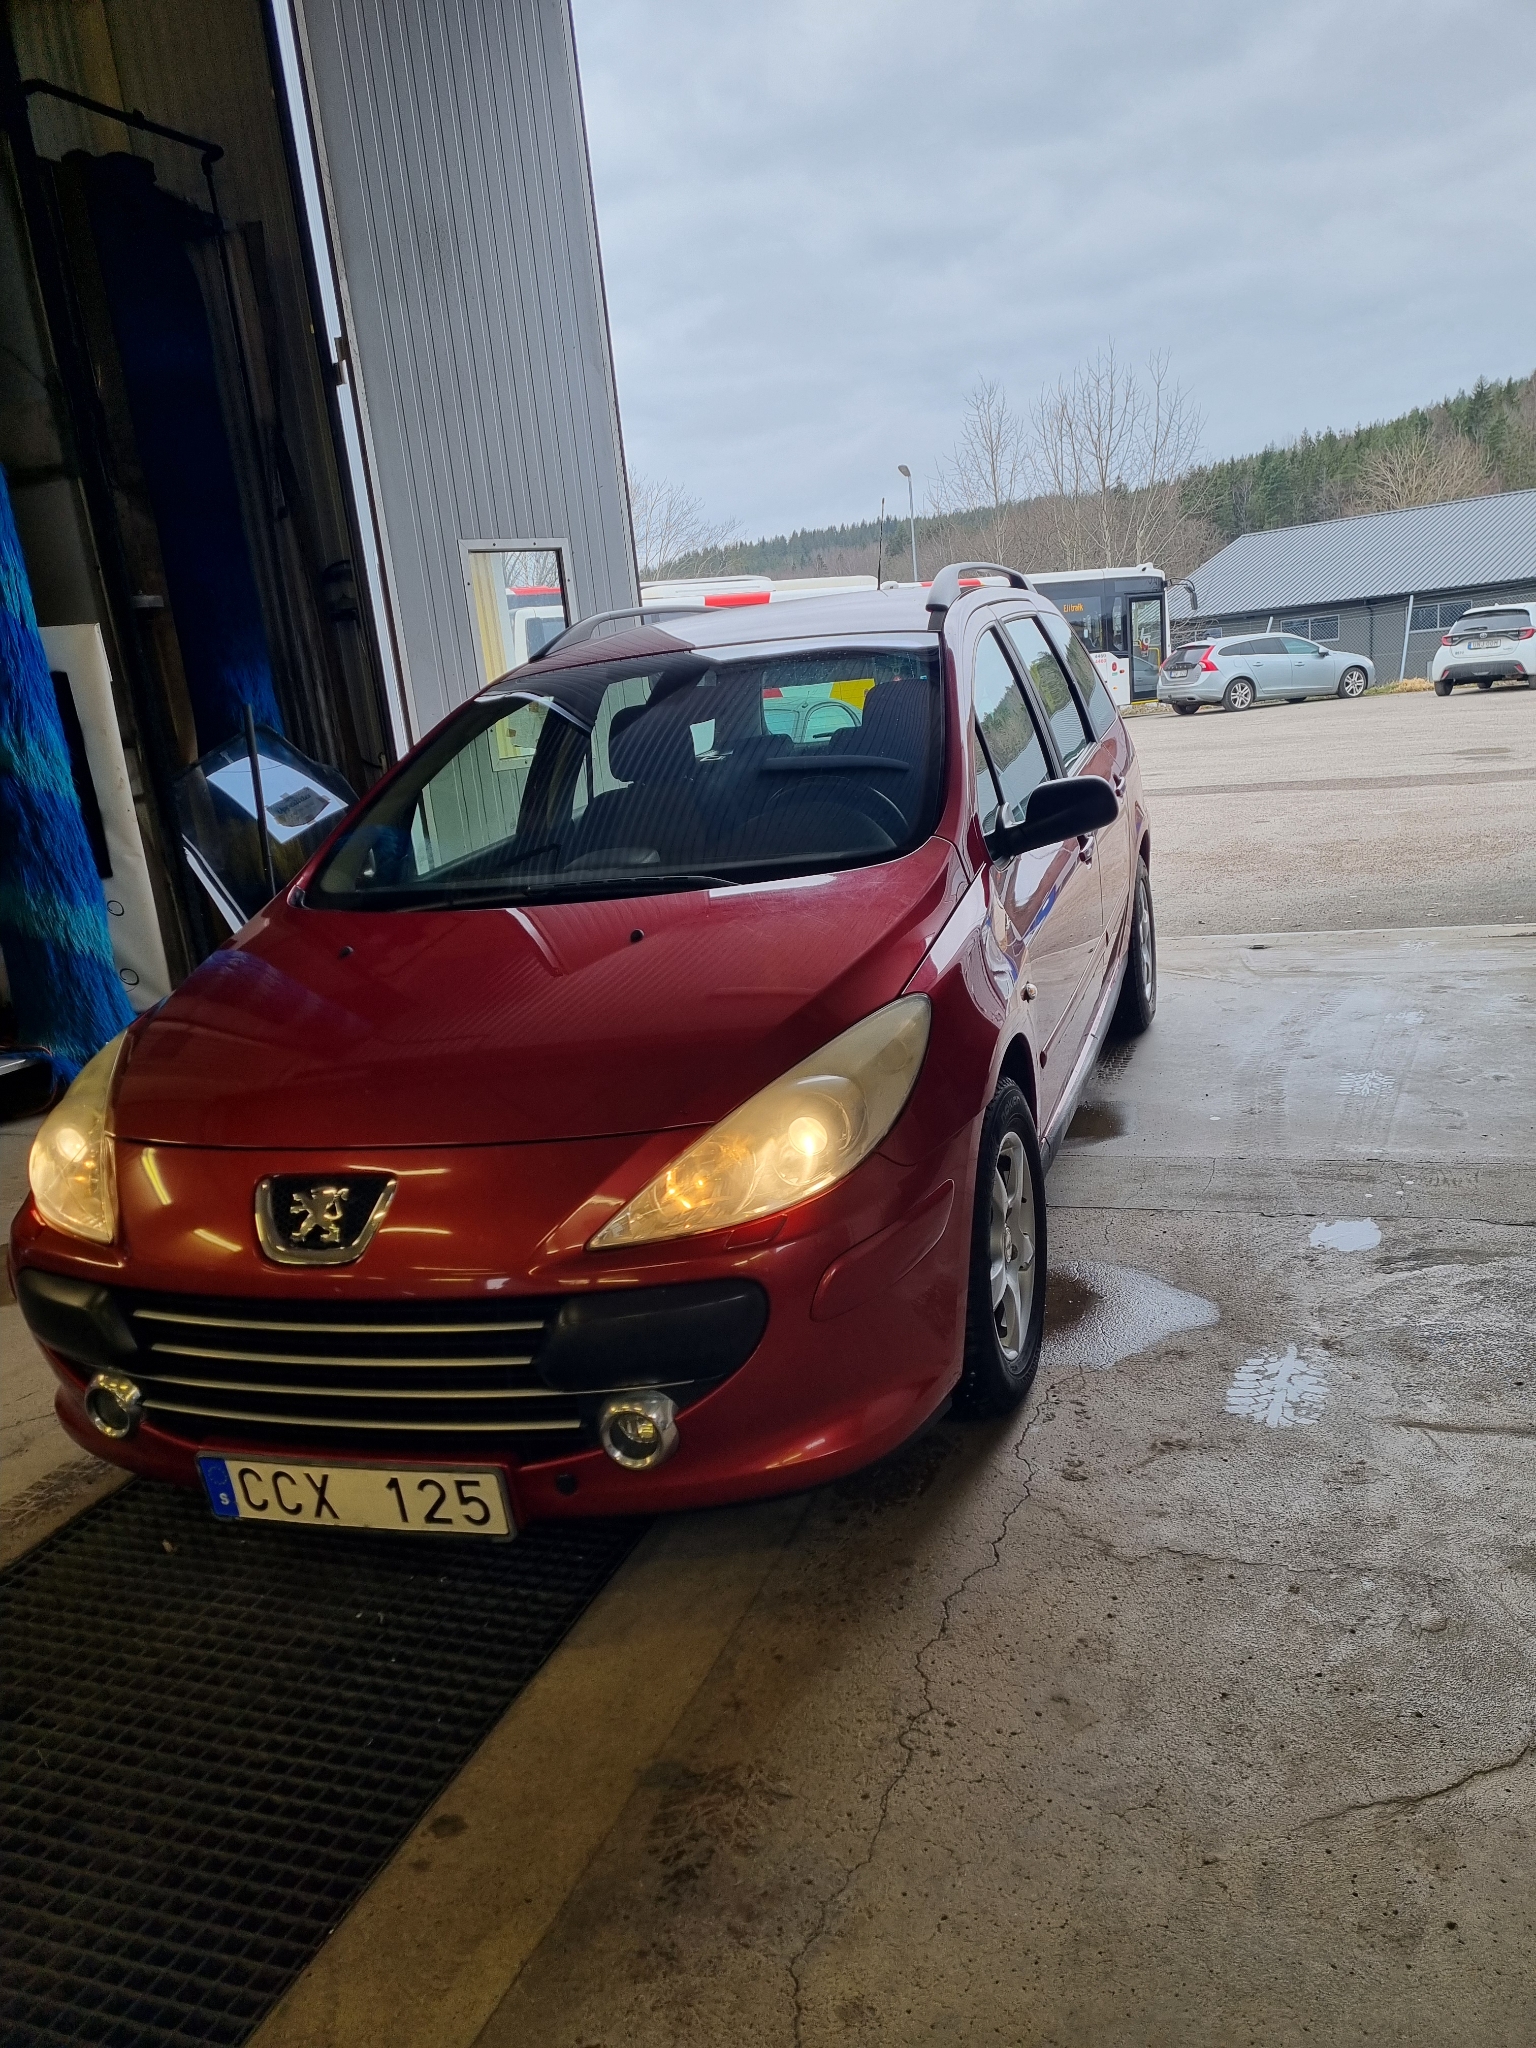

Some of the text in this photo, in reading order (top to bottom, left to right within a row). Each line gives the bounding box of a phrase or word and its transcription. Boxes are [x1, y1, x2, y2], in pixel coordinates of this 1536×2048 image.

[219, 1492, 230, 1506] S
[238, 1467, 492, 1526] CCX 125
